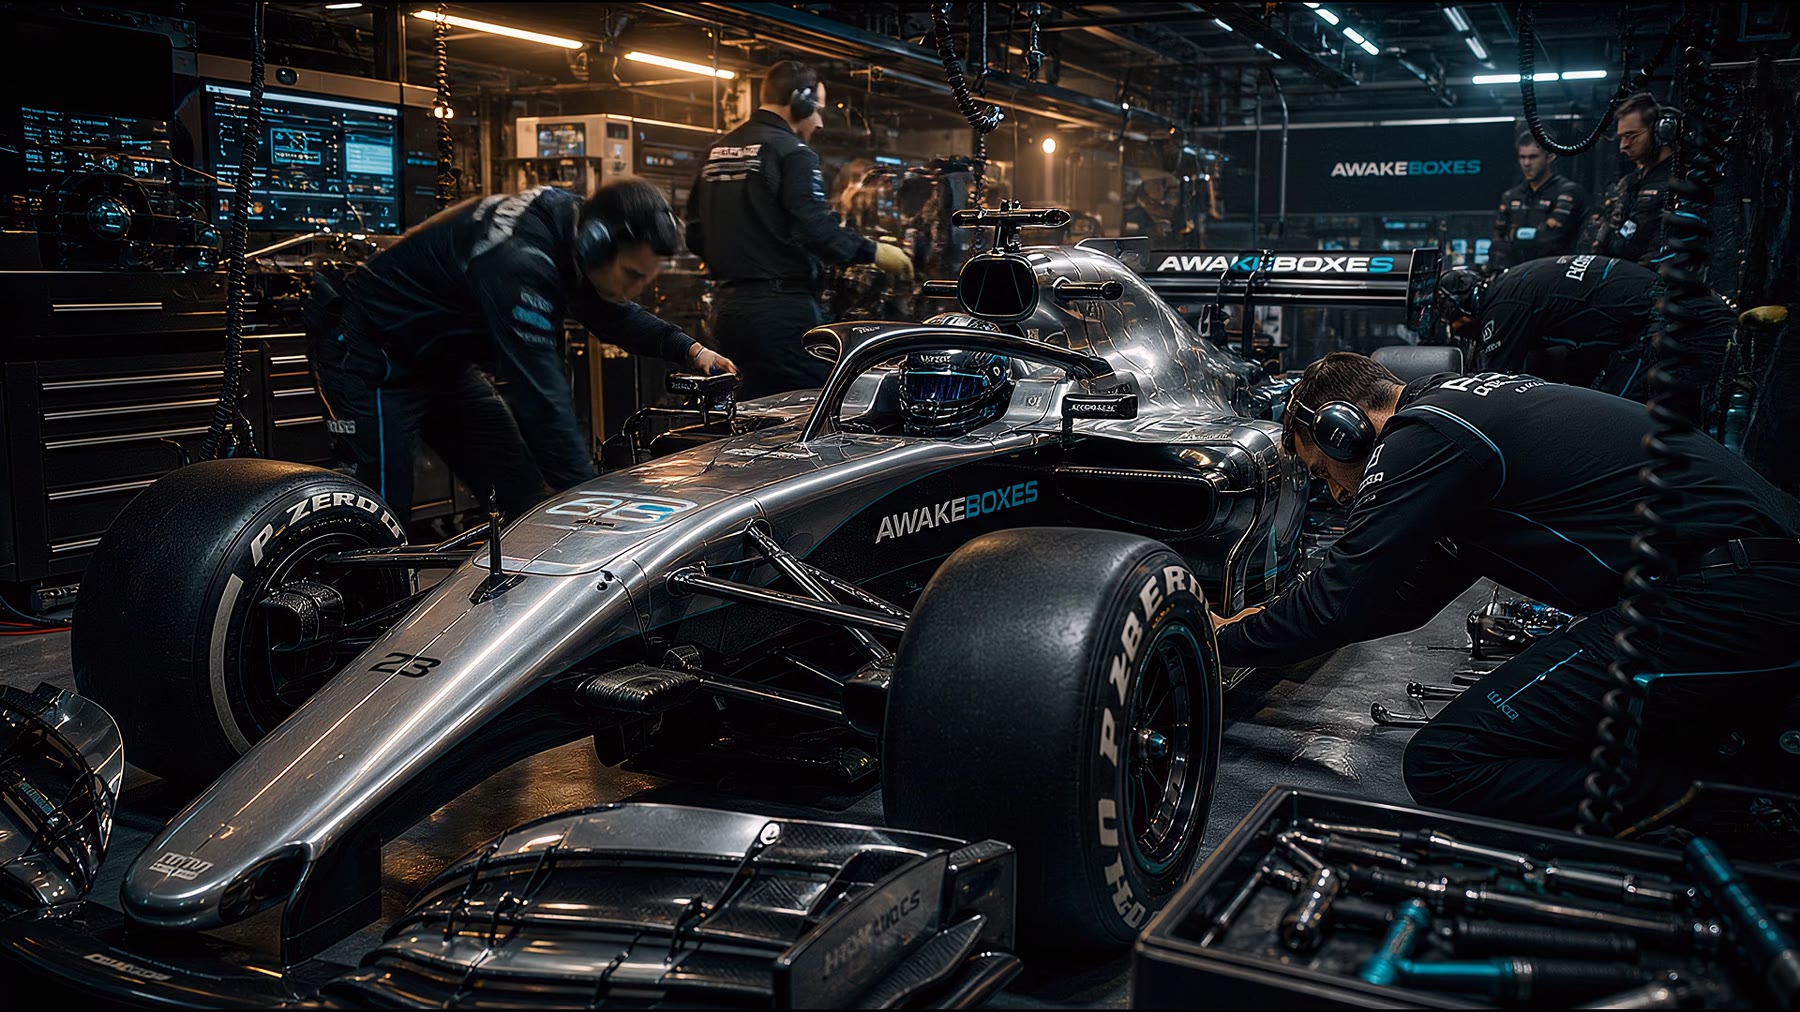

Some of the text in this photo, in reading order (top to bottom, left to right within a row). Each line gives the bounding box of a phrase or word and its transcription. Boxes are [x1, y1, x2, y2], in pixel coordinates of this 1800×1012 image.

[1331, 160, 1481, 177] AWAKEBOXES
[875, 480, 1038, 544] AWAKEBOXES
[250, 523, 274, 567] P
[368, 652, 442, 678] 23
